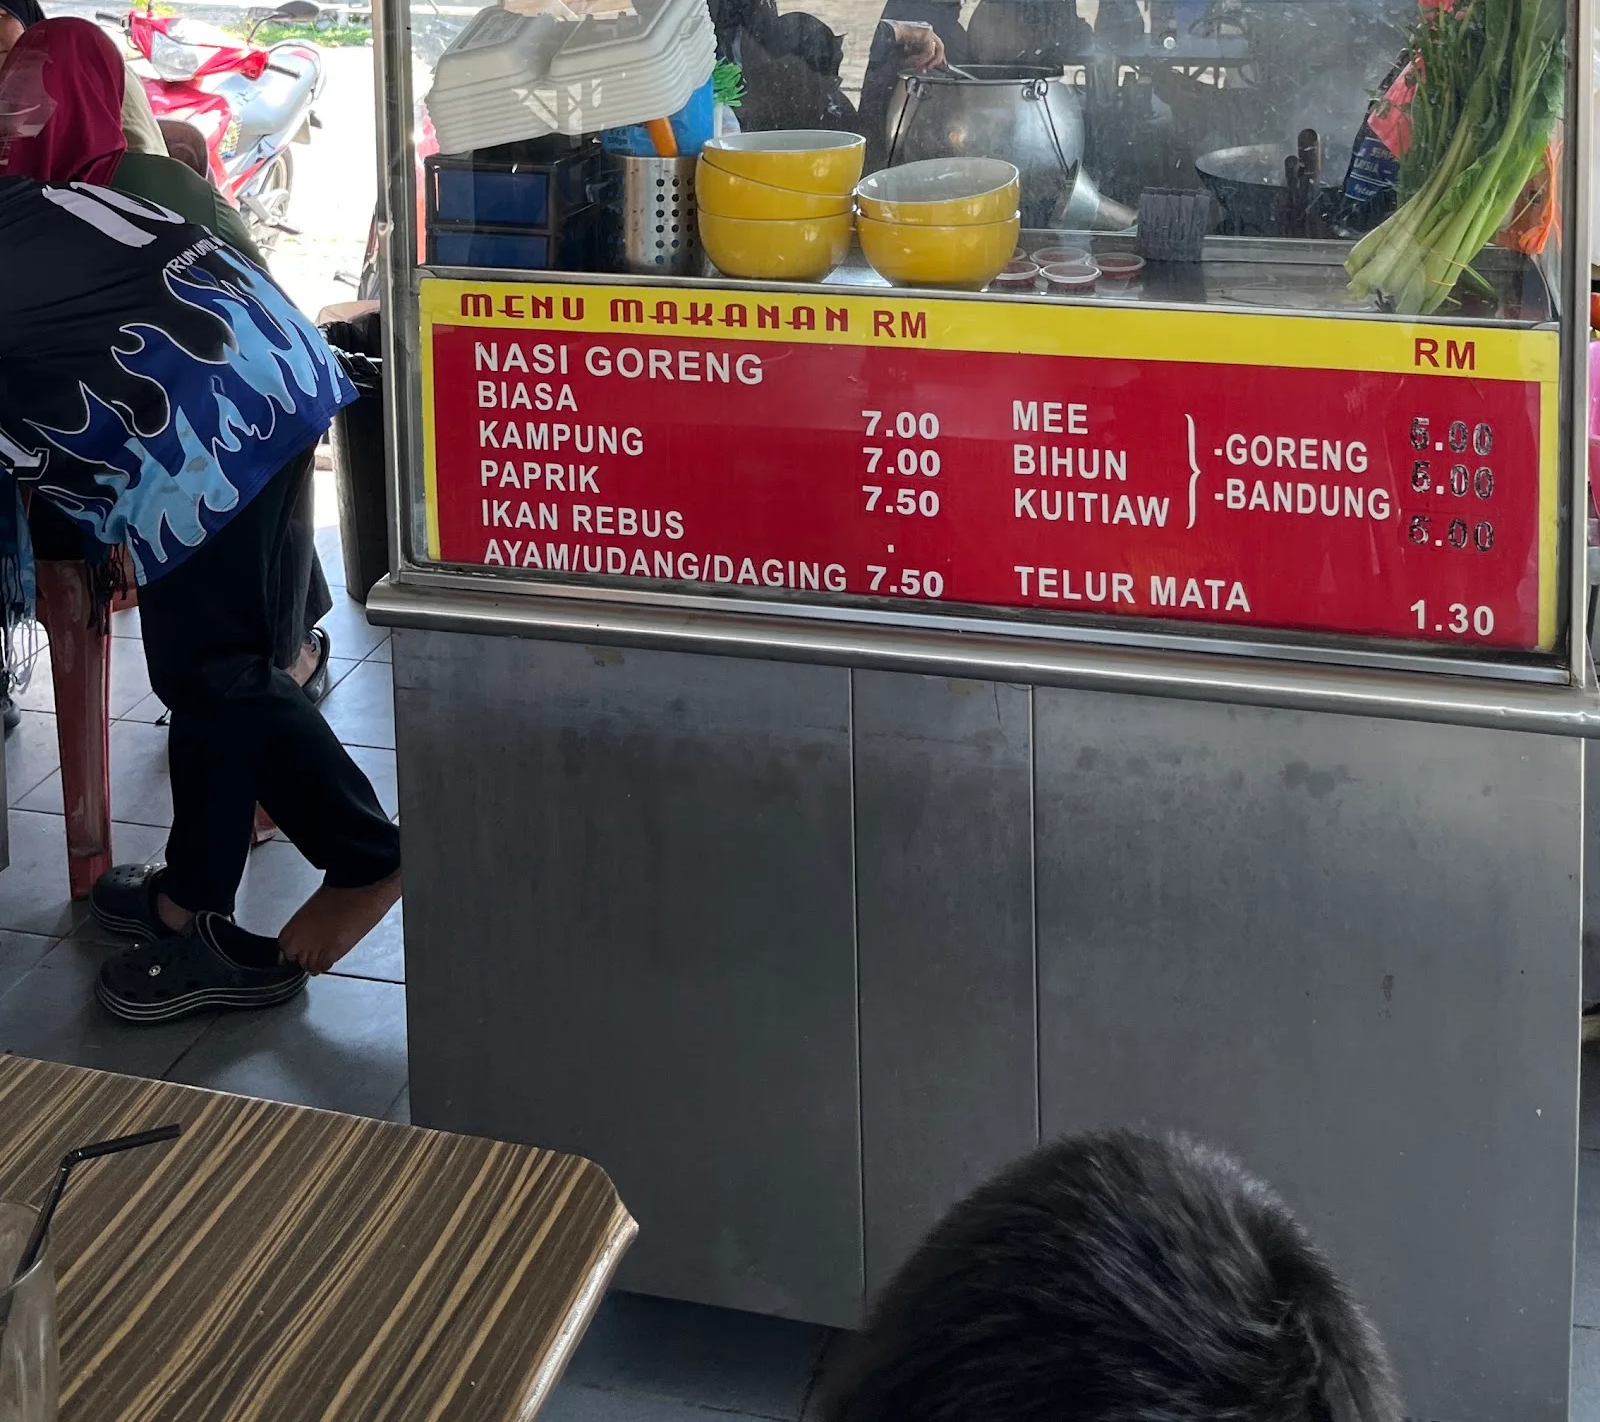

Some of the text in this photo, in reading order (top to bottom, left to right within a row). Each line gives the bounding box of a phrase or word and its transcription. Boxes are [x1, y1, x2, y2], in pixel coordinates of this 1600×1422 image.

[166, 247, 199, 274] RUN
[461, 293, 927, 339] MENU MAKANAN RM
[475, 342, 763, 385] NASI GORENG
[1414, 337, 1476, 371] RM
[478, 381, 940, 440] BIASA 7.00
[1012, 400, 1088, 435] MEE
[479, 421, 941, 477] KAMPUNG 7.00
[1013, 444, 1127, 481] BIHUN
[481, 460, 939, 517] PAPRIK 7.50
[1015, 489, 1169, 527] KUITIAW
[482, 499, 684, 540] IKAN REBUS
[483, 539, 944, 598] AYAM/UDANG/DAGING 7.50
[1014, 566, 1250, 613] TELUR MATA
[1410, 599, 1495, 636] 1.30
